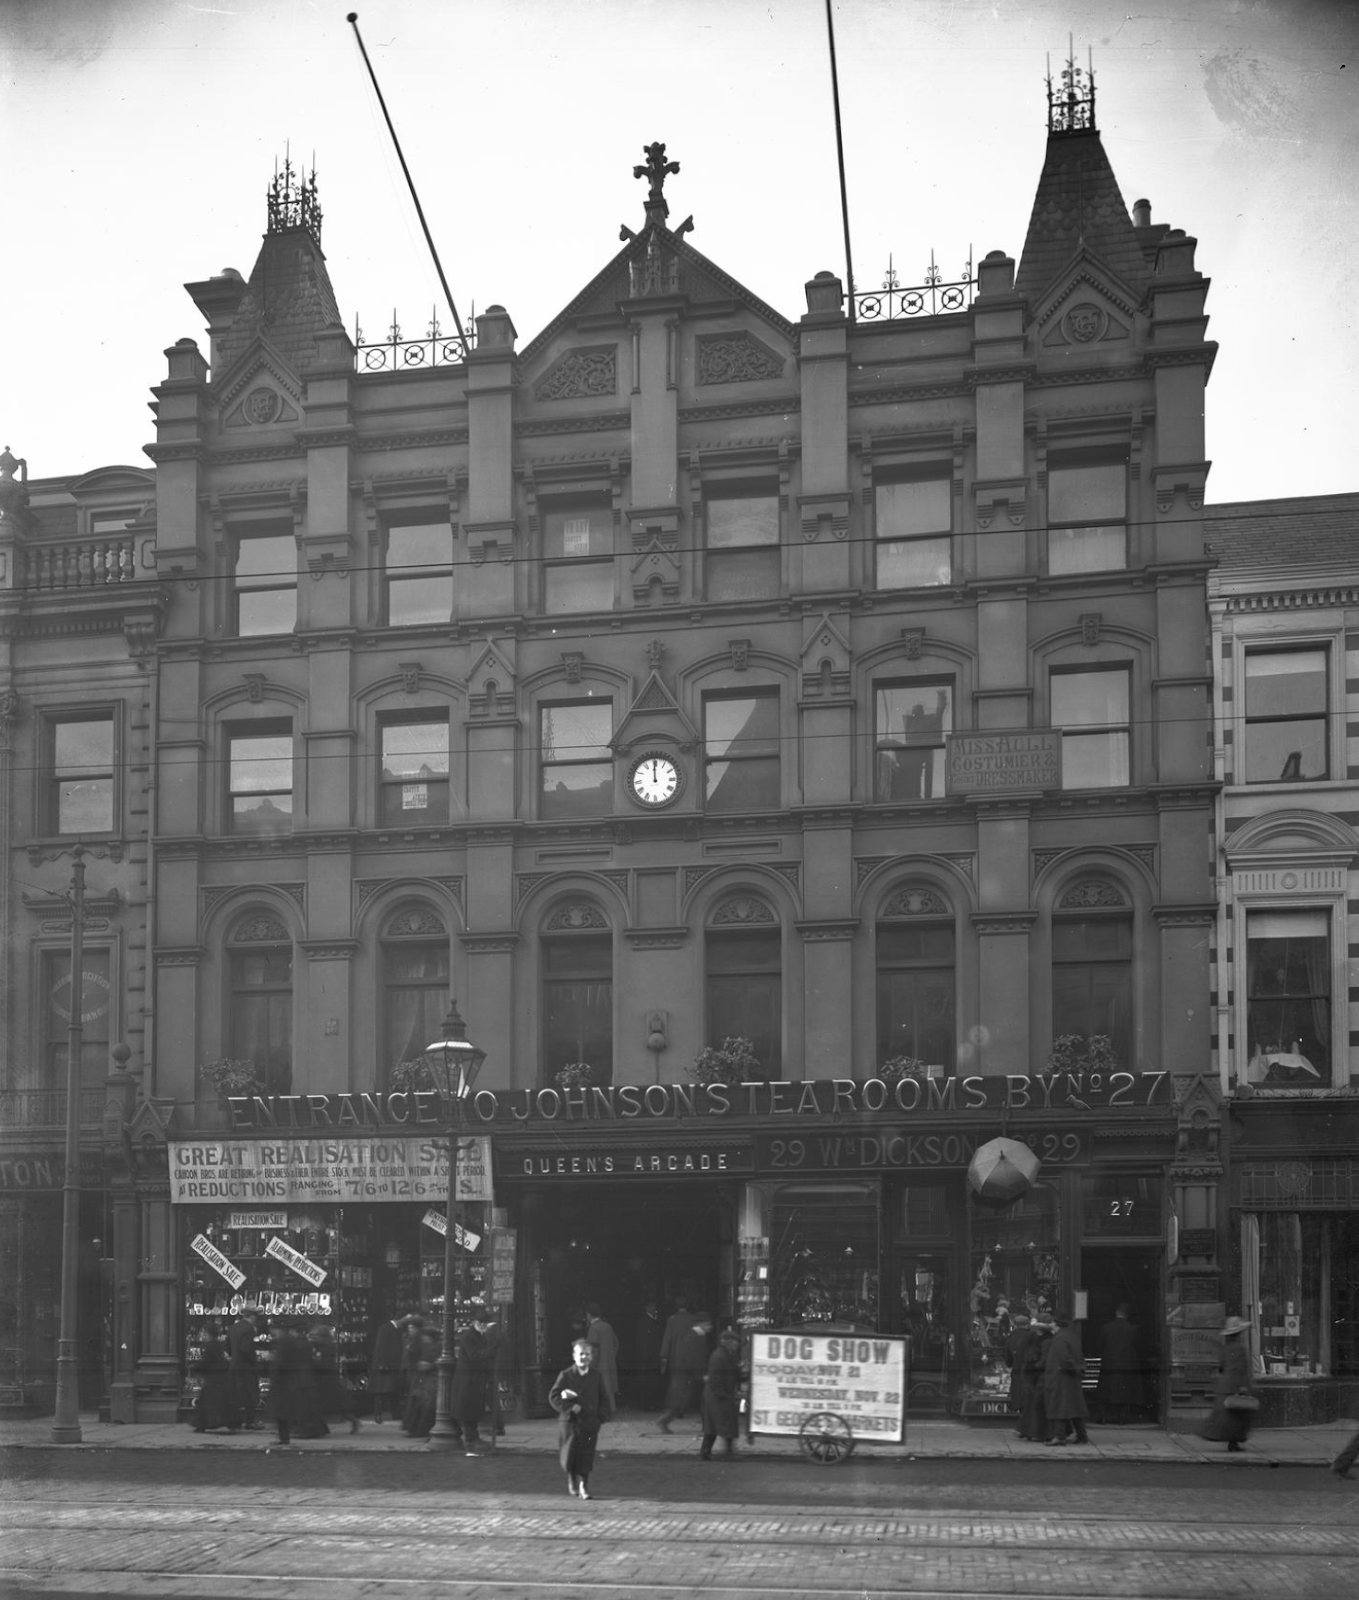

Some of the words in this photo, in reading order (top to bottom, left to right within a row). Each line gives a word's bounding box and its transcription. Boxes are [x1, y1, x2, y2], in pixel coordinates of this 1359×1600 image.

[955, 738, 995, 755] MISS
[952, 754, 1041, 772] COSTUMIER
[1044, 752, 1056, 768] &
[976, 769, 1057, 787] DRESSMAKER
[228, 1092, 439, 1128] ENTRANCE
[510, 1083, 731, 1120] JOHNSON'S
[741, 1080, 821, 1116] TEA
[832, 1076, 987, 1113] ROOMS
[1006, 1074, 1061, 1110] BY
[1109, 1071, 1168, 1107] 27
[177, 1146, 248, 1166] GREAT
[261, 1144, 406, 1165] REALISATION
[770, 1140, 806, 1167] 29
[859, 1134, 979, 1166] DICKSON
[1042, 1132, 1081, 1162] 29
[218, 1168, 229, 1179] ARE
[331, 1166, 349, 1178] STOCK
[433, 1166, 439, 1176] A
[523, 1156, 614, 1175] QUEEN'S
[634, 1154, 727, 1171] ARCADE
[188, 1181, 287, 1198] REDUCTIONS
[290, 1180, 334, 1190] RANGING
[345, 1179, 377, 1196] 7/6
[378, 1183, 388, 1194] TO
[1110, 1200, 1134, 1216] 27
[233, 1213, 269, 1226] REALISATION
[270, 1213, 284, 1225] SALE
[194, 1237, 227, 1270] REALISATION
[222, 1263, 242, 1284] SALE
[767, 1336, 814, 1360] DOG
[827, 1339, 891, 1364] SHOW
[884, 1392, 900, 1404] 22
